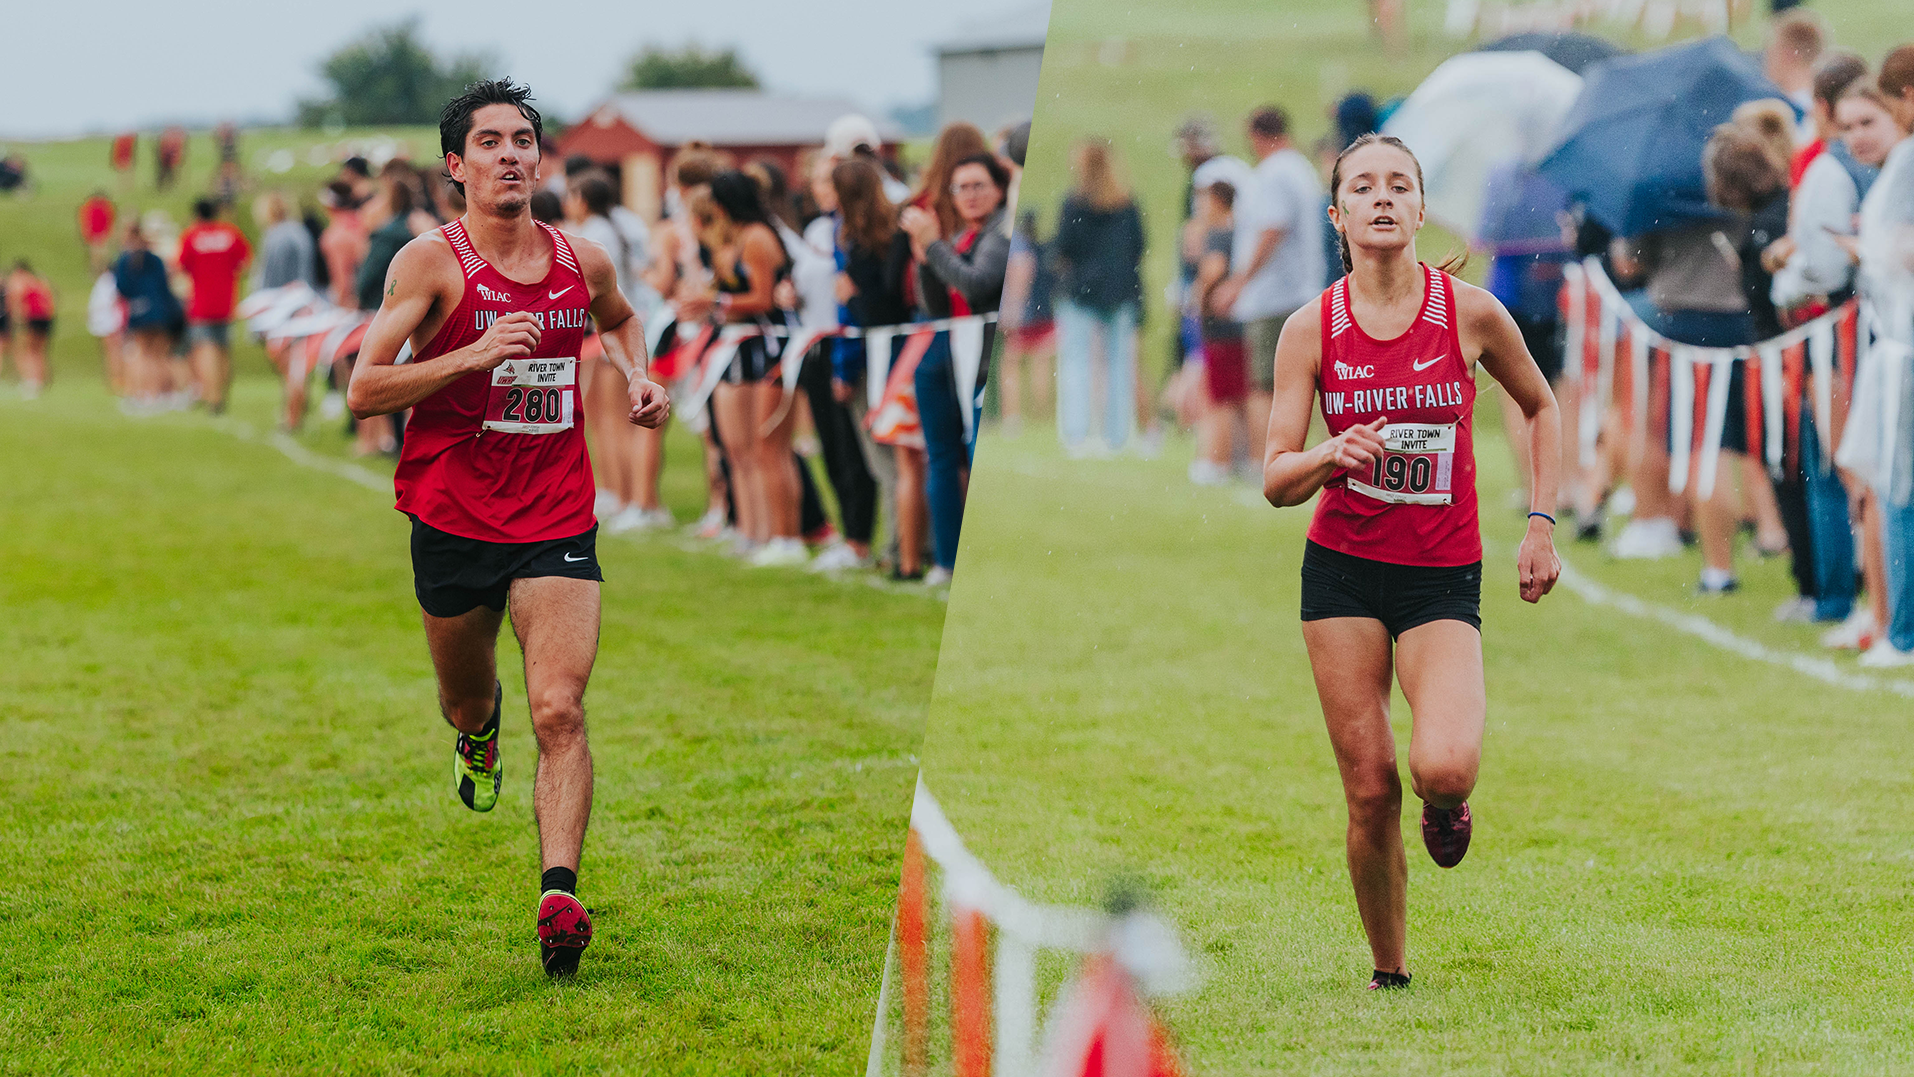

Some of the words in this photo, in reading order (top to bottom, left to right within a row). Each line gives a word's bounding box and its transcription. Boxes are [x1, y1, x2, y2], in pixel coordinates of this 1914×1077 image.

[479, 288, 512, 303] WIAC
[549, 308, 585, 330] FALLS
[528, 363, 547, 373] RIVER
[549, 362, 566, 372] TOWN
[1336, 365, 1375, 380] WIAC
[537, 373, 557, 383] INVITE
[502, 388, 560, 423] 280
[1325, 386, 1408, 415] UW-RIVER
[1415, 381, 1463, 409] FALLS
[1390, 429, 1414, 439] RIVER
[1417, 429, 1441, 439] TOWN
[1401, 440, 1428, 450] INVITE
[1372, 454, 1432, 494] 190
